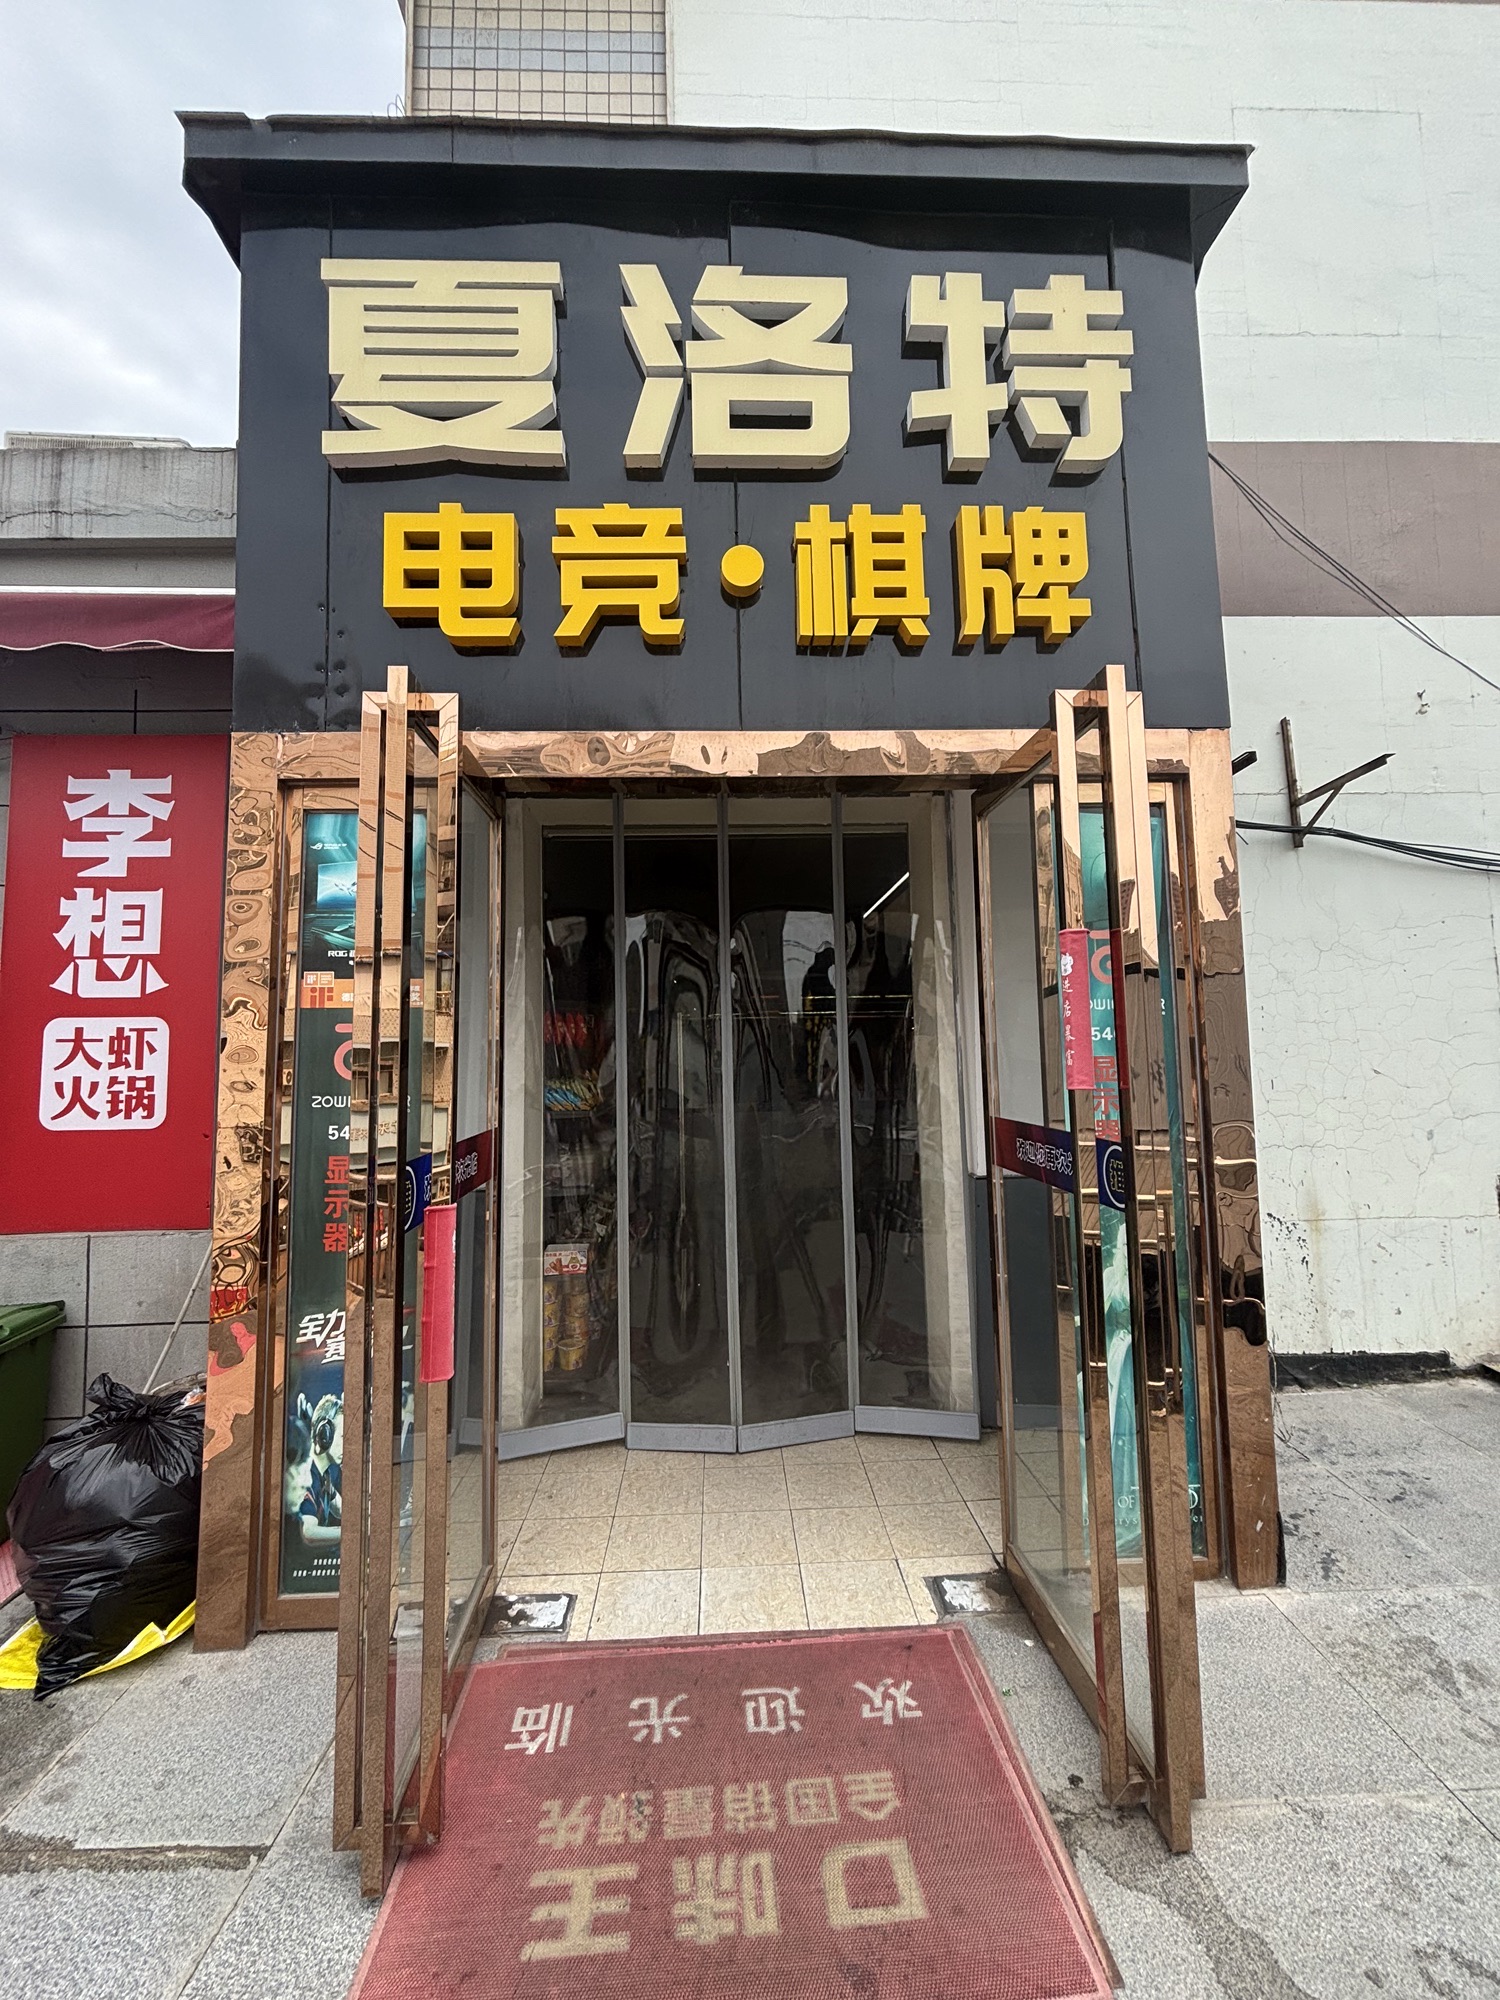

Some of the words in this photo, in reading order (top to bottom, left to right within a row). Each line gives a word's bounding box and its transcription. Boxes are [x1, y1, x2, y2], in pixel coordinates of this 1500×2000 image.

[320, 258, 1135, 475] 夏洛特
[49, 768, 176, 999] 李想
[54, 1026, 158, 1071] 大虾
[1091, 1026, 1116, 1041] 54
[50, 1075, 156, 1121] 火锅
[311, 1095, 351, 1108] ZOWI
[328, 1125, 350, 1140] 54
[323, 1156, 349, 1253] 显示器
[1118, 1495, 1135, 1508] OF
[503, 1677, 923, 1756] 欢迎光临
[536, 1769, 901, 1852] 全国销量领先
[522, 1838, 928, 1960] 口味王
